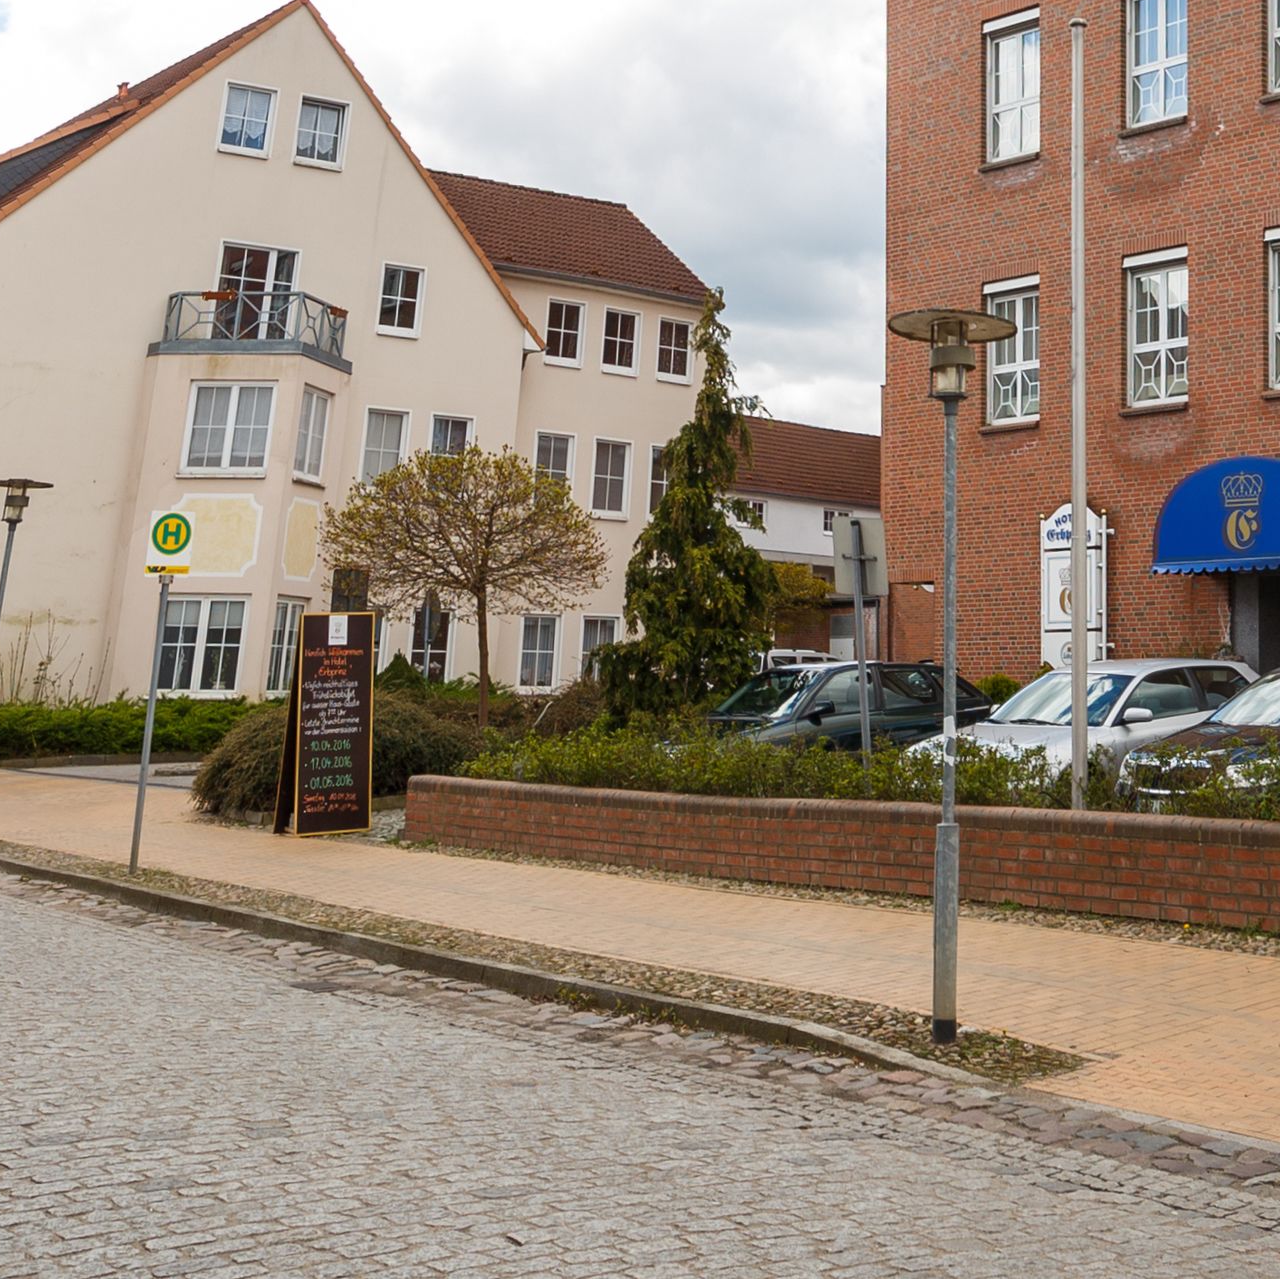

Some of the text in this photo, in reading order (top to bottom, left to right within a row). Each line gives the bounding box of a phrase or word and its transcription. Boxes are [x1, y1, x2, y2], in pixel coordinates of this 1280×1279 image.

[162, 523, 182, 545] H
[310, 739, 351, 751] 10.04.2016
[310, 756, 352, 771] 17.04.2016
[309, 774, 353, 790] 01.05.2016
